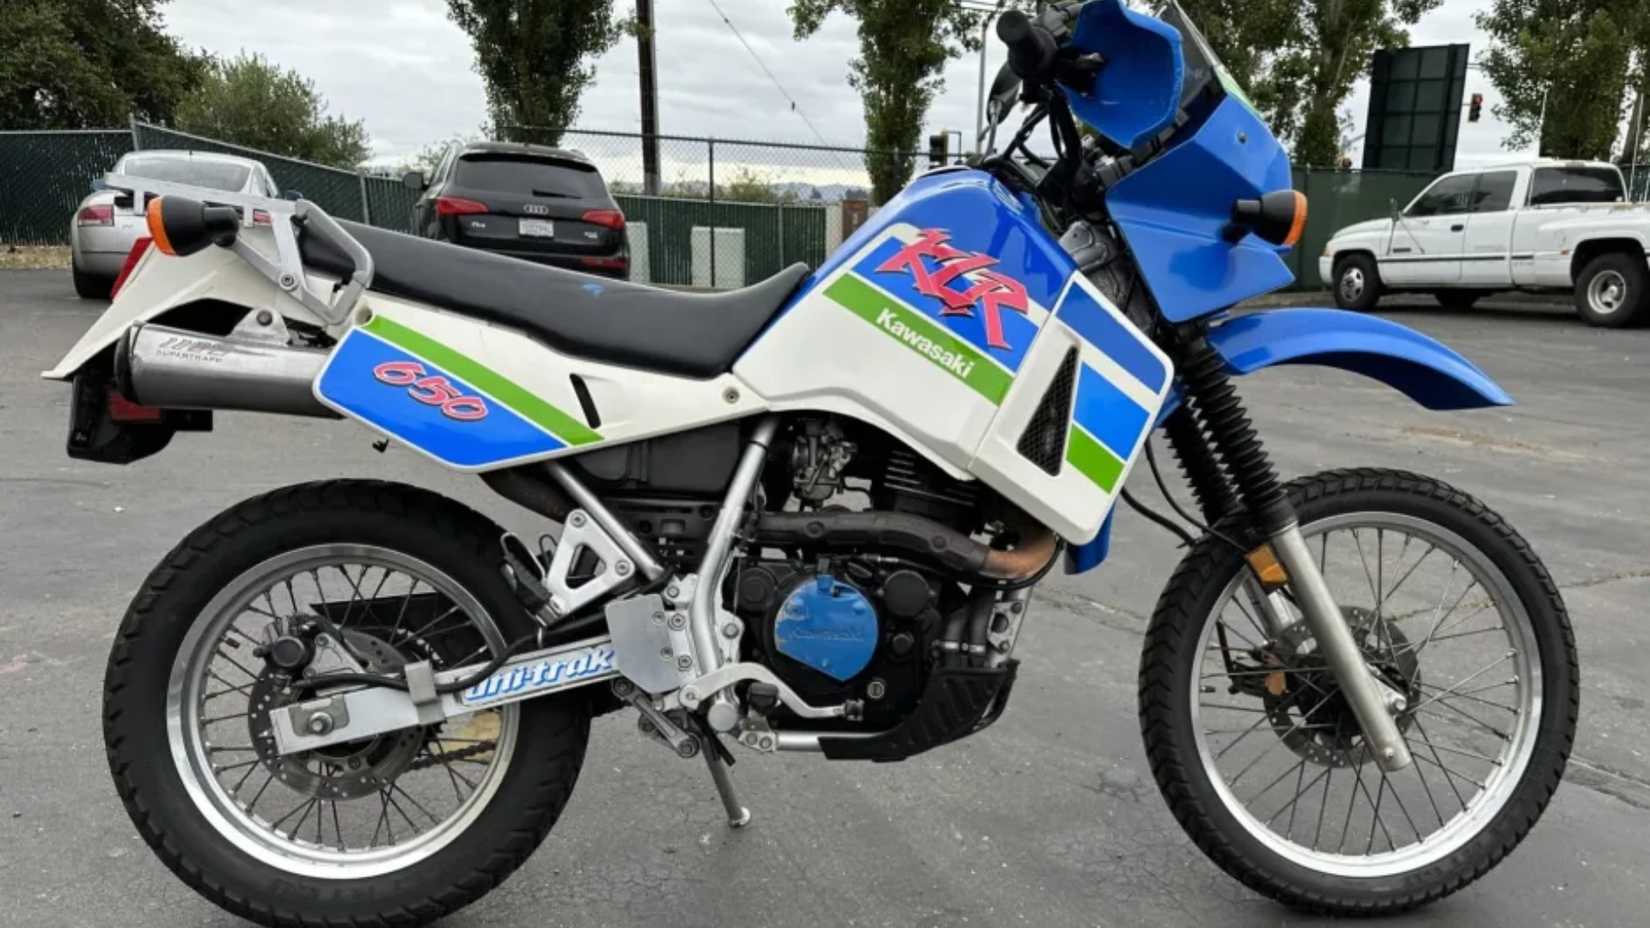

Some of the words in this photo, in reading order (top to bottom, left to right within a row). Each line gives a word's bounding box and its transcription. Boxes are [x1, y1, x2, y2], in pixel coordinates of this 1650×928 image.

[875, 227, 1028, 350] KLR
[876, 307, 975, 378] Kawasaki
[373, 361, 489, 421] 650
